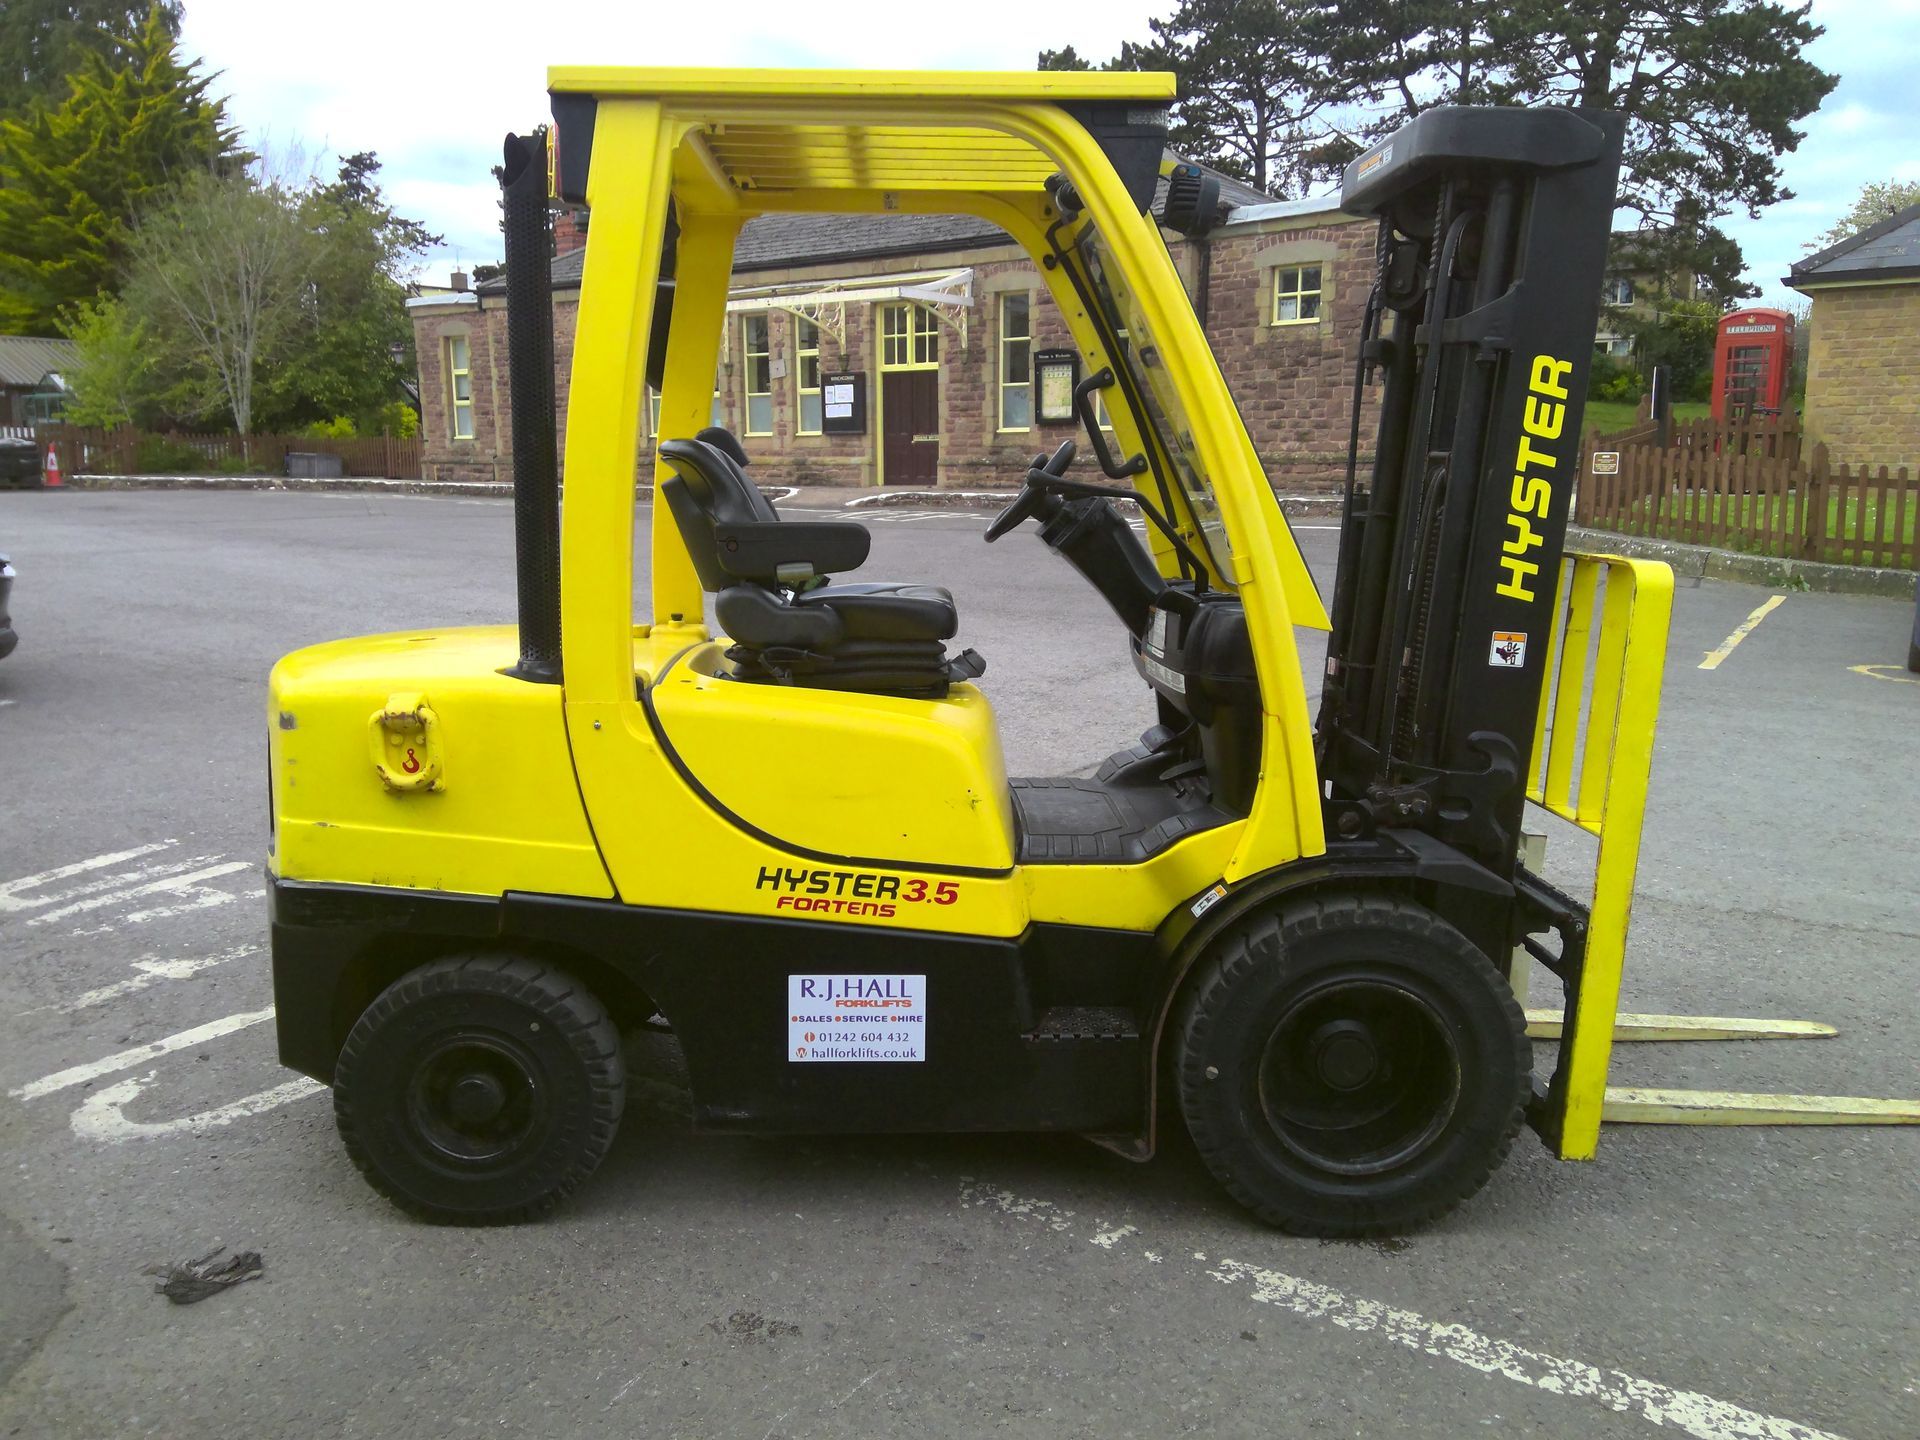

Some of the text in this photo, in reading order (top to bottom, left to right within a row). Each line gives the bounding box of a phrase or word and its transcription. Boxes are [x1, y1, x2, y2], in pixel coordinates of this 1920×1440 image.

[1496, 354, 1573, 603] HYSTER
[756, 866, 960, 905] HYSTER 3.5
[776, 896, 896, 918] FORTENS
[835, 999, 912, 1008] FORKLIFTS
[799, 1015, 923, 1023] SALES SERVICE HIRE
[819, 1032, 910, 1042] 01242 604 432
[811, 1047, 917, 1058] hallforklifts.co.uk
